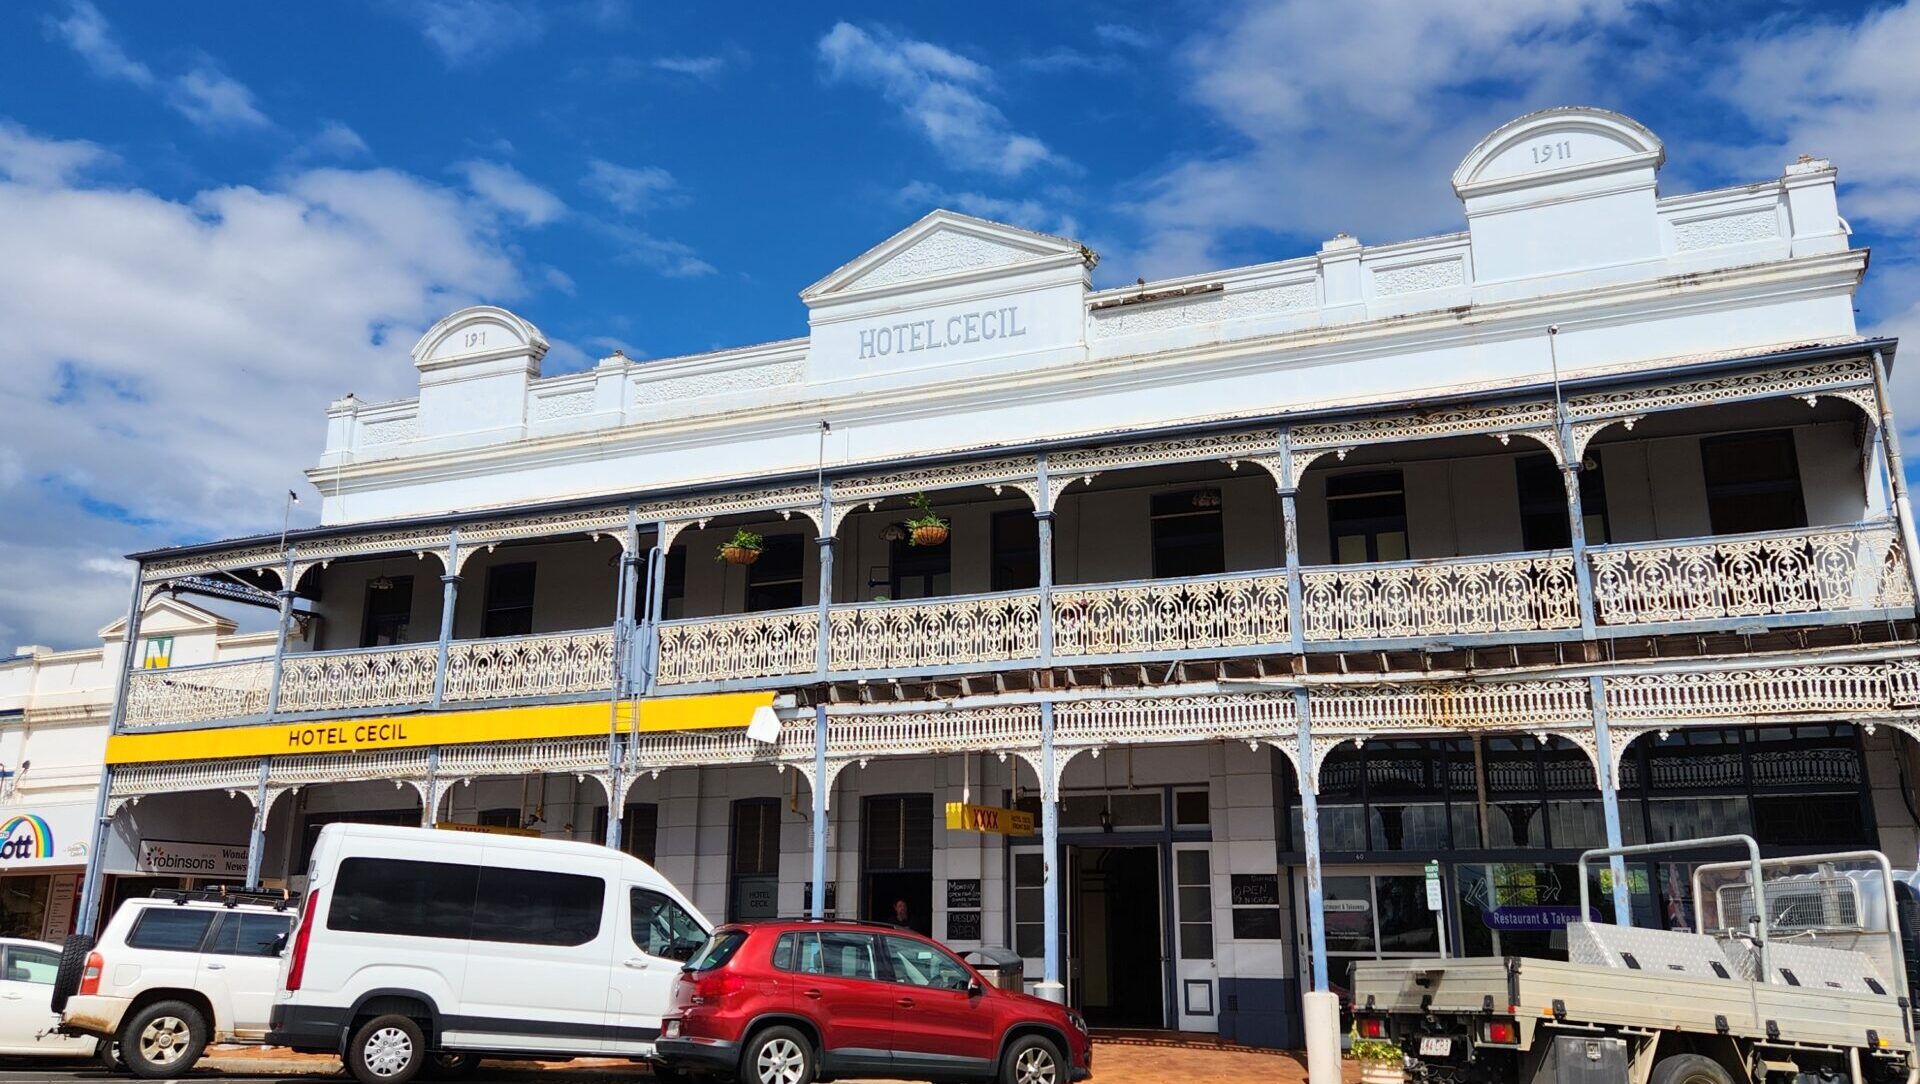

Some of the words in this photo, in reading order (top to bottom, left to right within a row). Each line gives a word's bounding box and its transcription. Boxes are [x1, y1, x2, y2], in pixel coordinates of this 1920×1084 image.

[1532, 140, 1571, 164] 1911
[465, 331, 486, 348] 191
[288, 727, 348, 746] HOTEL
[355, 724, 407, 742] CECIL
[974, 808, 999, 830] XXXX
[0, 835, 33, 859] ott
[154, 855, 215, 869] robinsons
[1233, 884, 1267, 896] OPEN
[1493, 912, 1540, 924] Restaurant
[1542, 912, 1549, 924] &
